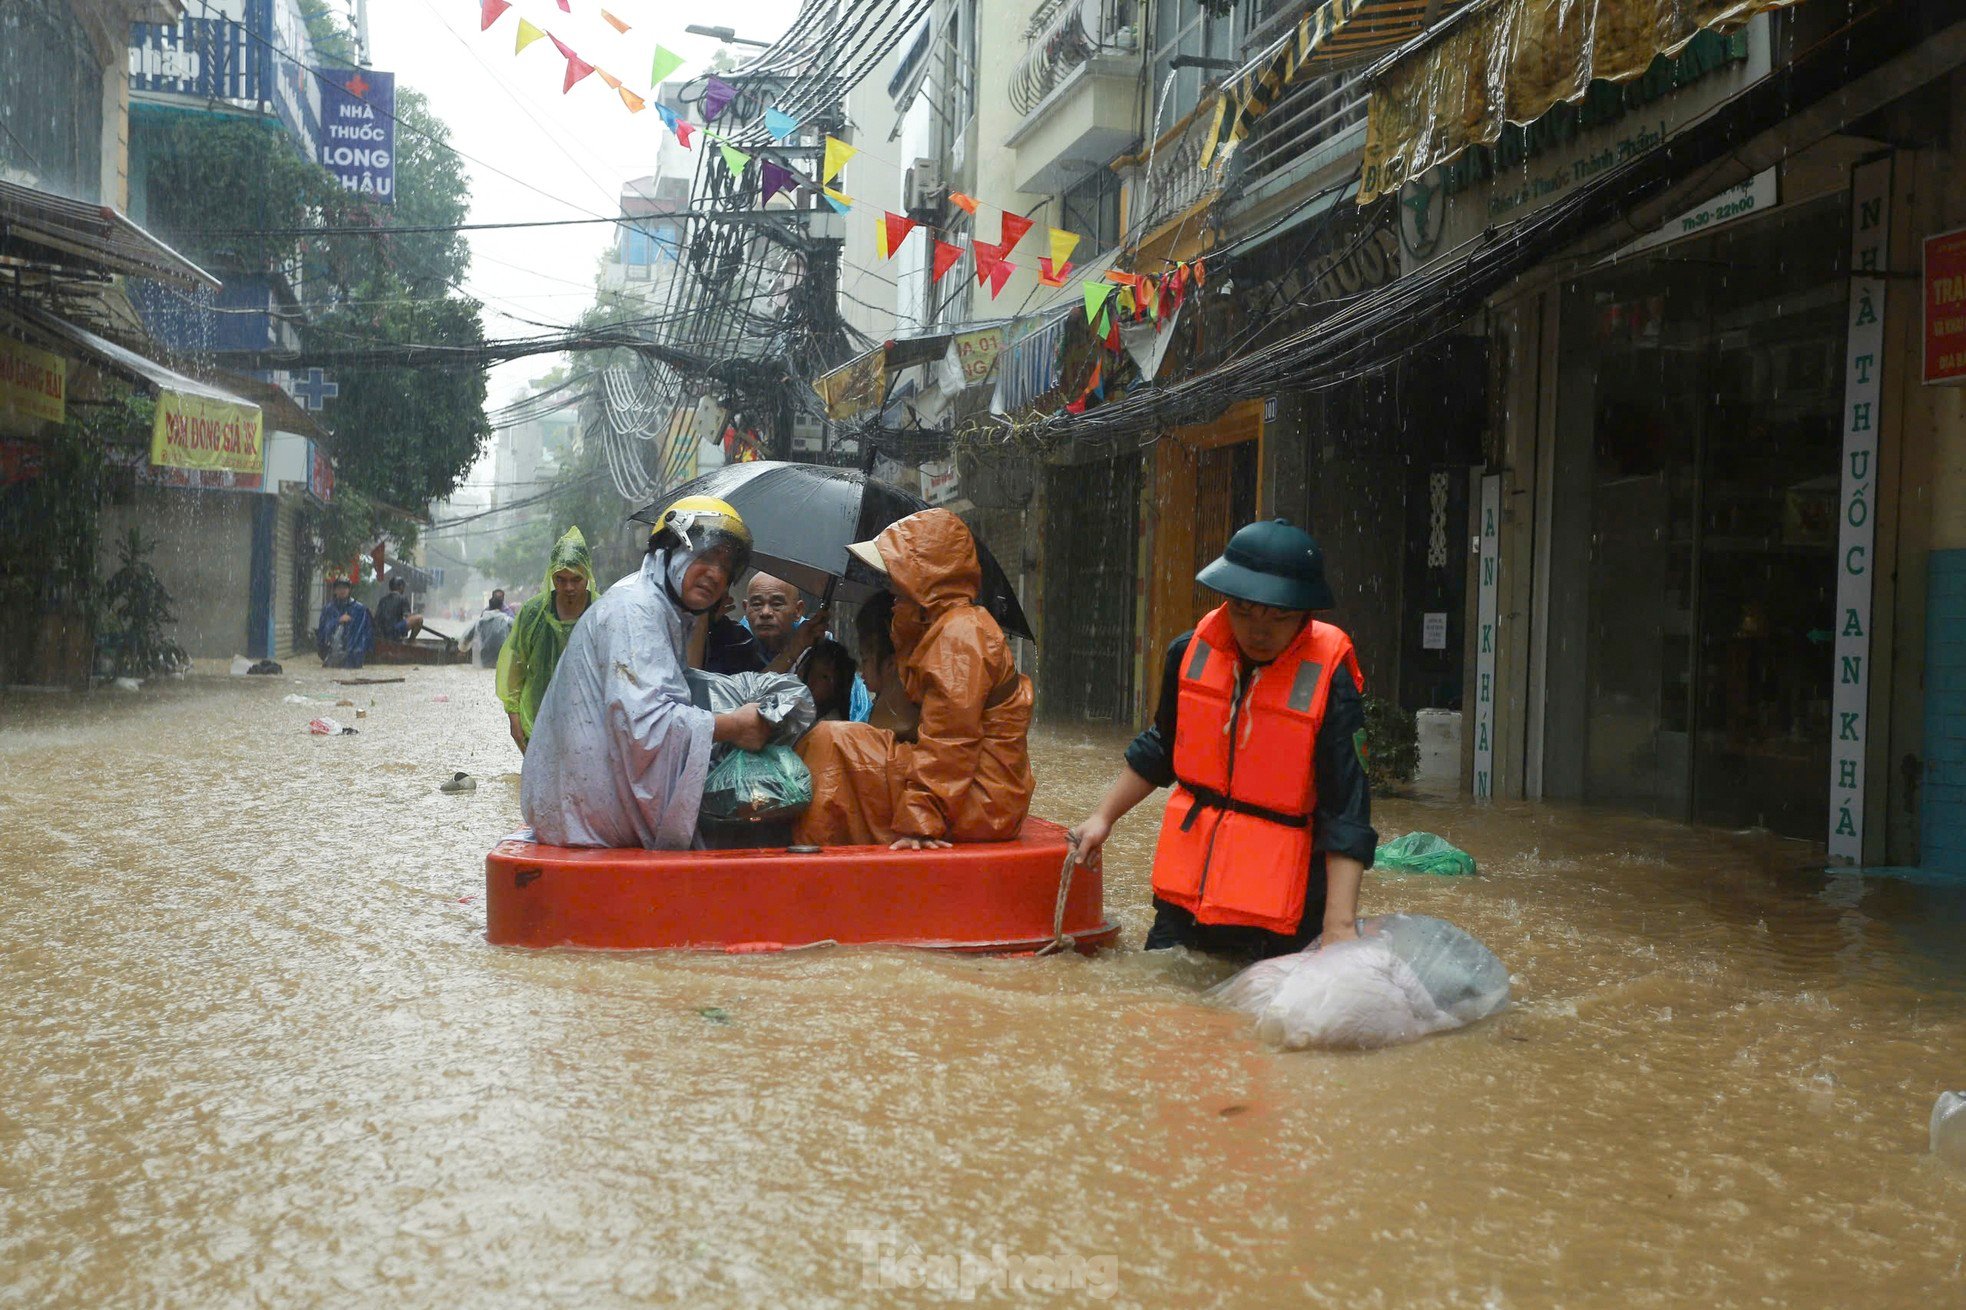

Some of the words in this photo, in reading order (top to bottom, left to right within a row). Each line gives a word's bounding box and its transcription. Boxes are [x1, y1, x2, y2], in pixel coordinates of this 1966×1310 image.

[329, 122, 385, 141] THUỐC
[340, 102, 375, 119] NHÀ
[323, 146, 390, 168] LONG
[333, 171, 391, 195] HÂU
[1856, 198, 1881, 326] NHÀ
[1846, 354, 1874, 576] THUỐC
[1484, 508, 1495, 586] AN
[1841, 608, 1863, 685] AN
[1834, 712, 1859, 864] KHÁ
